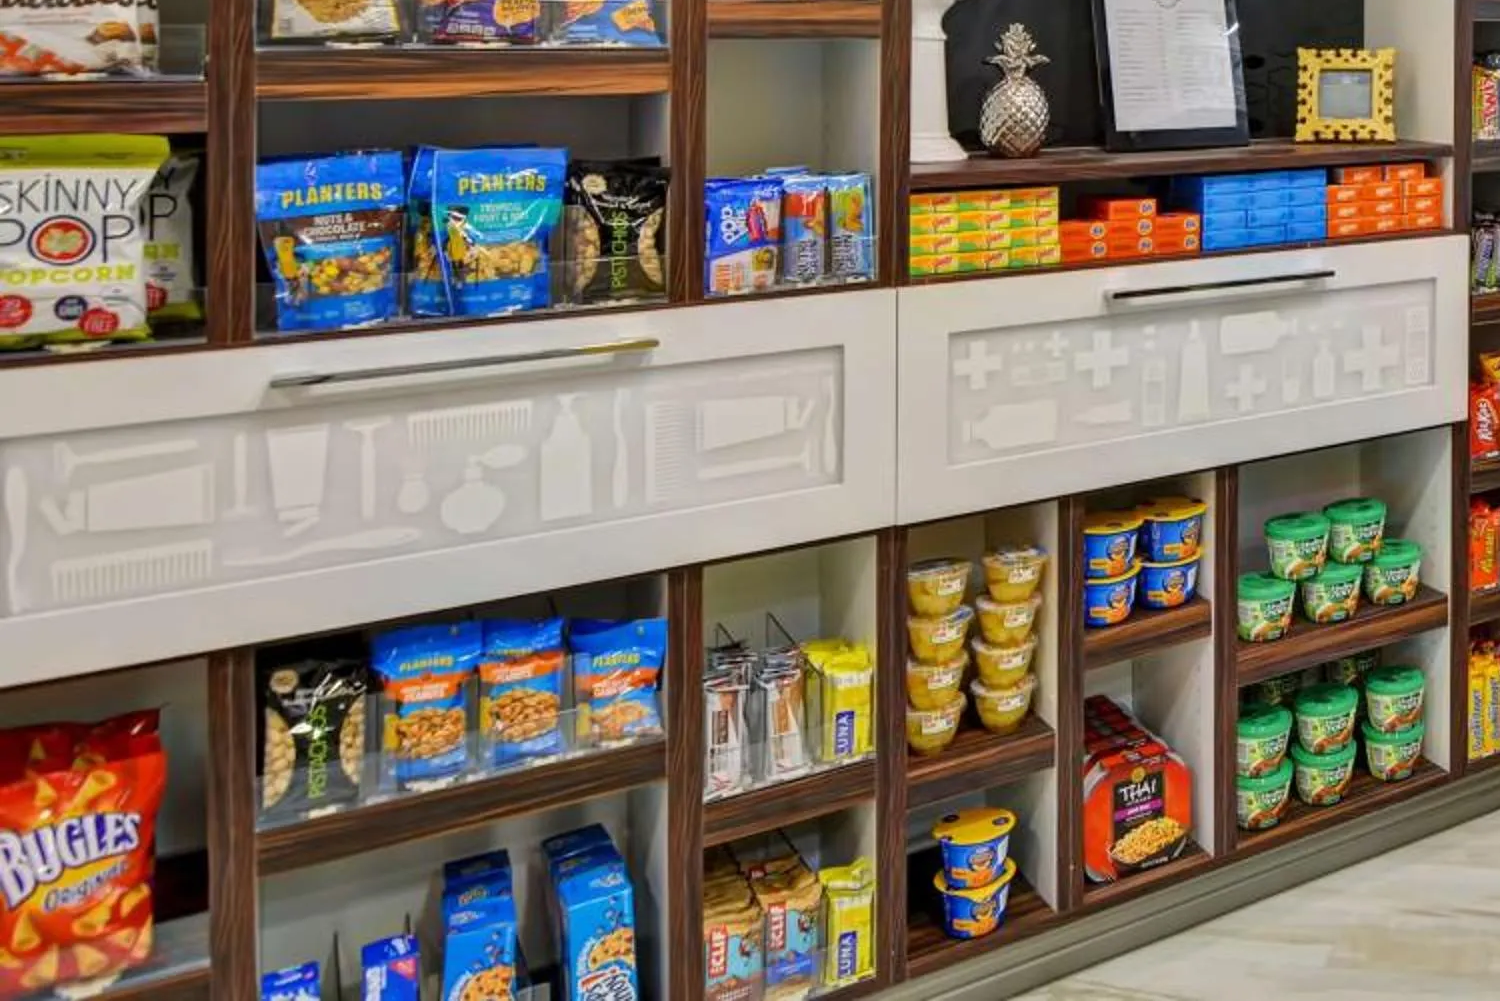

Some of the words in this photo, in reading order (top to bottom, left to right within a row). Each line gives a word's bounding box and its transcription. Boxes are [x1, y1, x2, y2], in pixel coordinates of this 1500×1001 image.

[0, 173, 138, 216] SKINNY
[281, 182, 383, 210] PLANTERS
[457, 173, 547, 196] PLANTERS
[611, 211, 629, 289] PISTCHIOS
[0, 263, 135, 286] OPCORN
[307, 704, 328, 800] PISTACHOS
[836, 713, 851, 755] LUNA
[1119, 777, 1158, 803] THAI
[0, 812, 140, 910] BUGLES
[840, 935, 853, 977] LUNA
